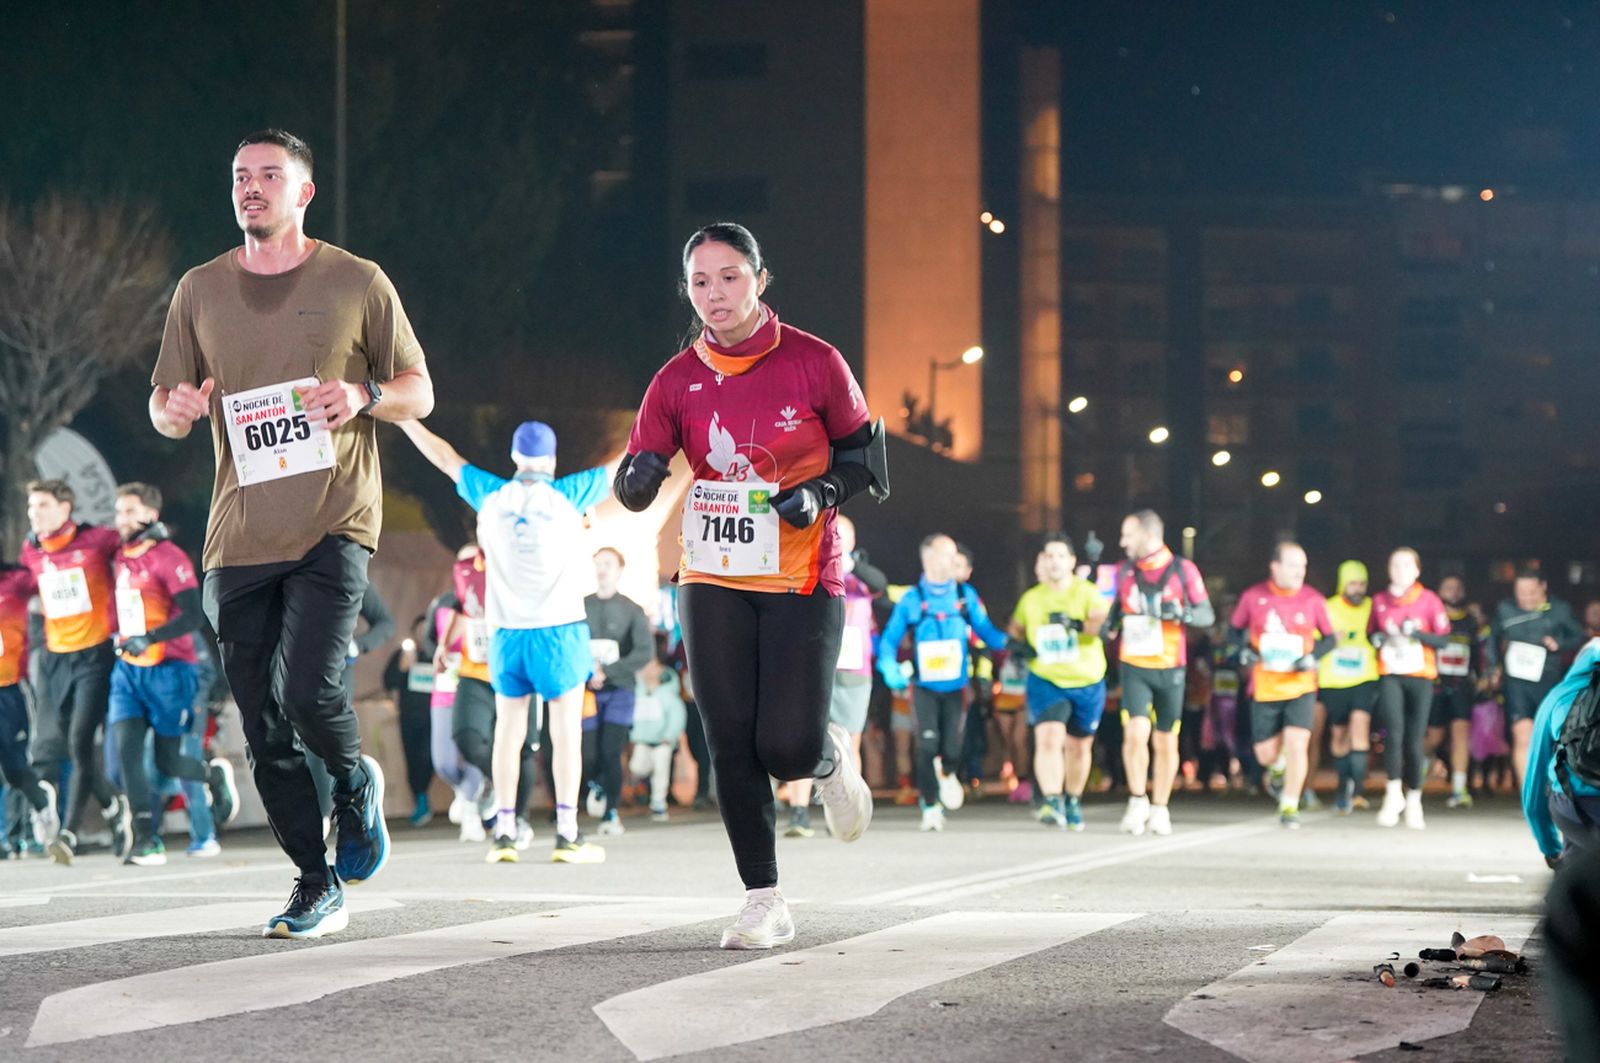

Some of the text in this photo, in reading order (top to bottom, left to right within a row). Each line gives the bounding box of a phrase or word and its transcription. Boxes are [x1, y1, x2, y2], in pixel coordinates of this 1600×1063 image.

[243, 398, 269, 411] NOCHE
[272, 394, 284, 406] DE
[236, 413, 253, 425] SAN
[254, 405, 286, 421] ANTÓN
[245, 415, 310, 450] 6025
[727, 461, 750, 481] 43
[703, 491, 726, 502] NOCHE
[727, 493, 739, 503] DE
[708, 502, 740, 514] ANTÓN
[702, 514, 754, 544] 7146
